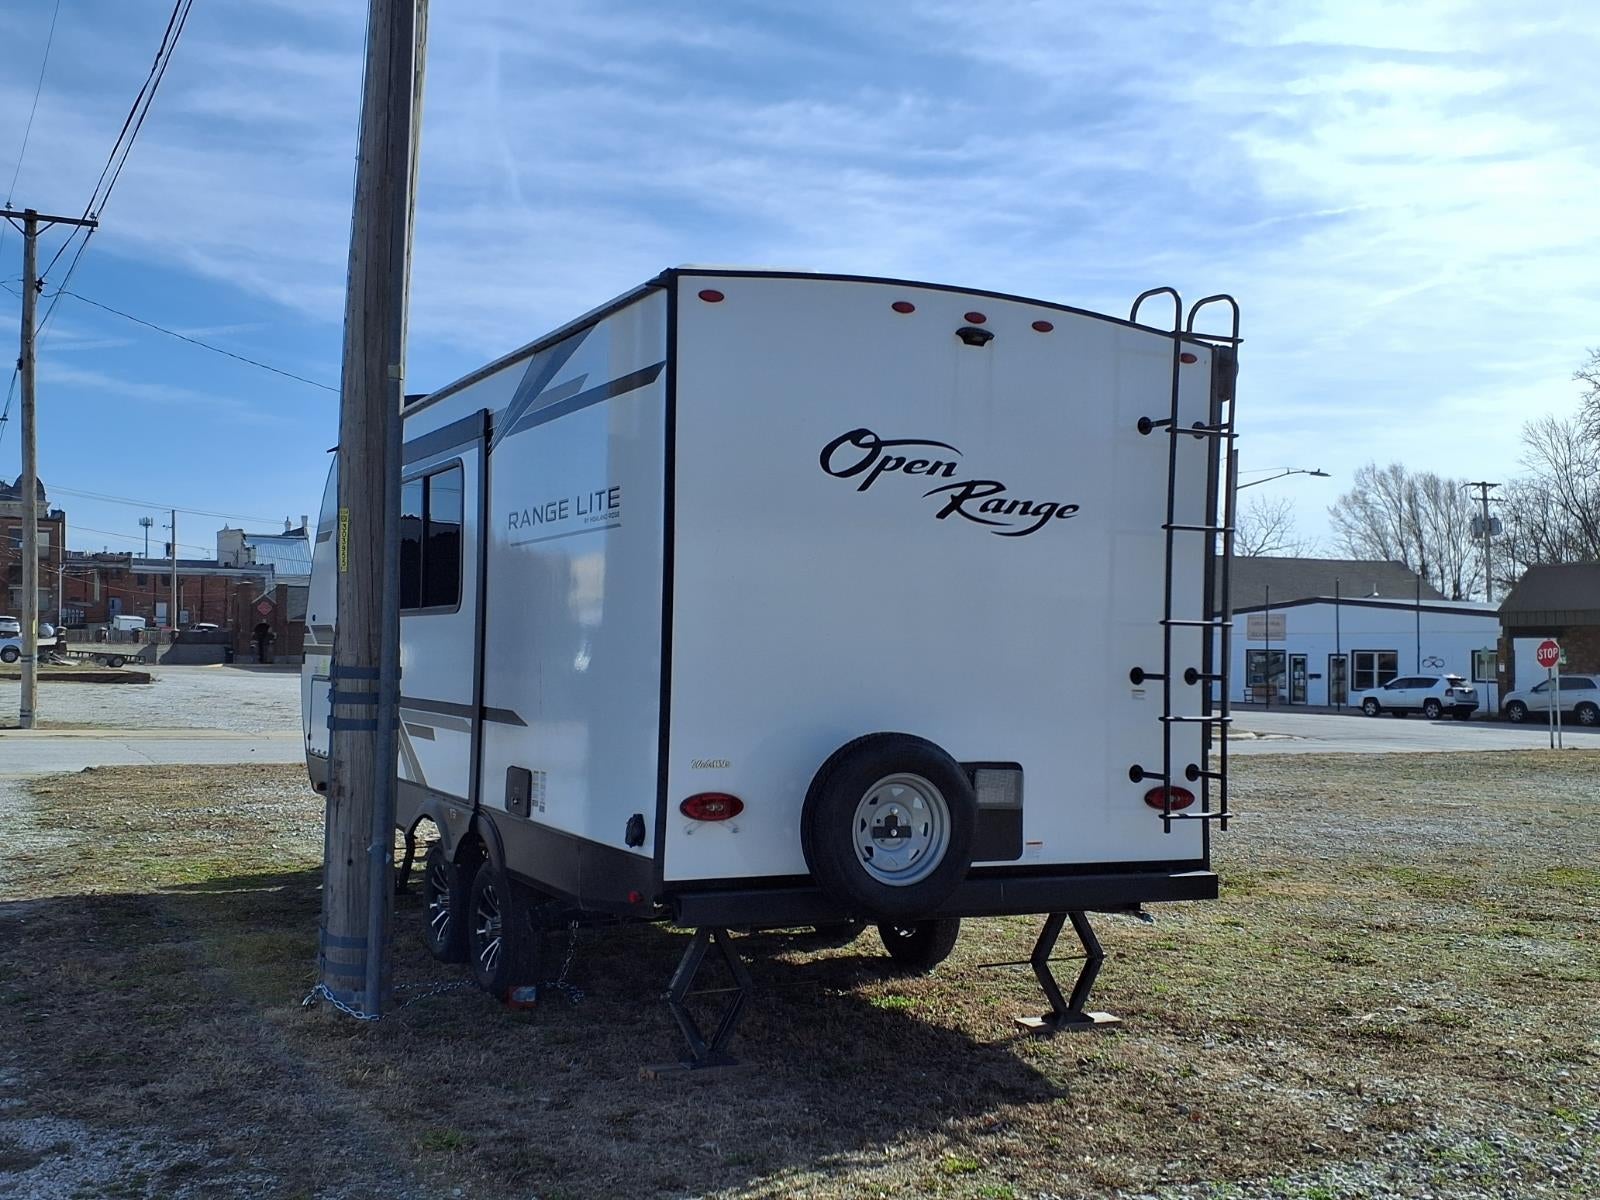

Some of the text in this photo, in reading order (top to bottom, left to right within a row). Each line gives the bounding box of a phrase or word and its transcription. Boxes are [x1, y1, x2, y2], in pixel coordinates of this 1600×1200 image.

[819, 428, 964, 491] Open
[508, 499, 569, 530] RANGE
[576, 485, 621, 516] LITE
[922, 480, 1080, 537] Range
[1538, 647, 1558, 660] STOP
